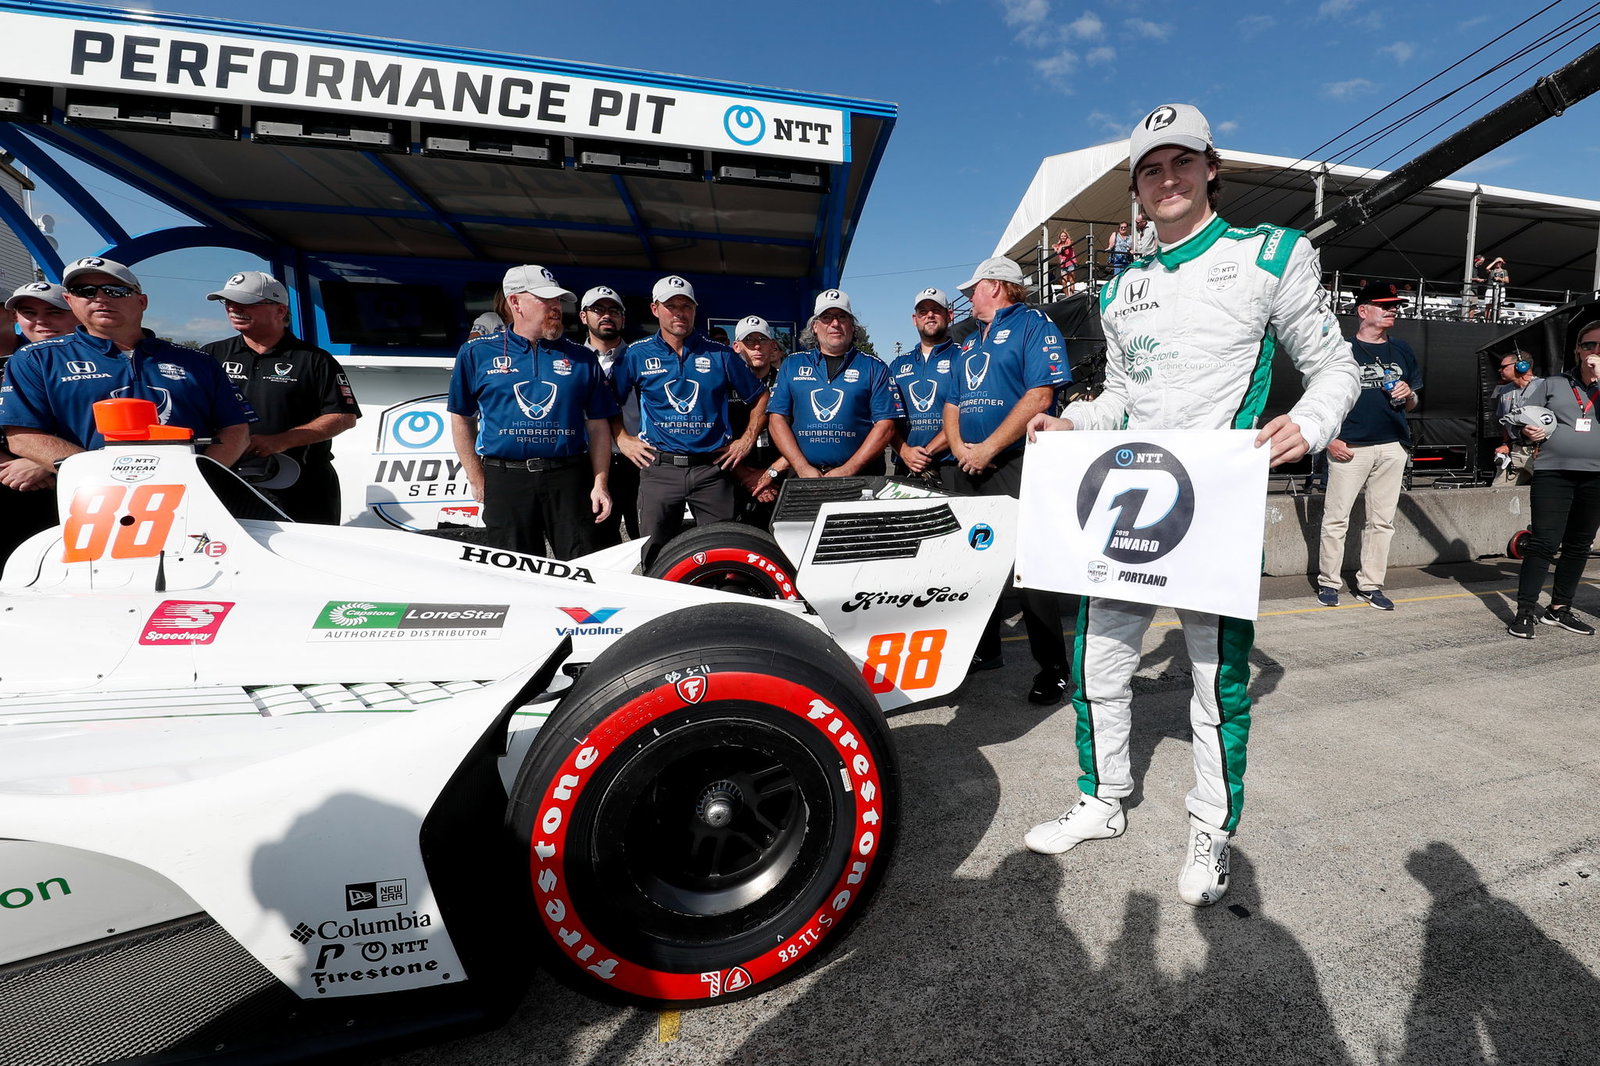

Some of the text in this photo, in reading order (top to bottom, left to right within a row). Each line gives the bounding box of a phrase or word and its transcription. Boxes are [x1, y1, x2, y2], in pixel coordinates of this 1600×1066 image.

[70, 29, 676, 135] PERFORMANCE PIT
[773, 117, 832, 146] NTT
[1221, 265, 1236, 274] NTT
[1206, 273, 1238, 284] INDYCAR
[1113, 301, 1160, 319] HONDA
[61, 372, 113, 382] HONDA
[641, 368, 668, 376] HONDA
[512, 420, 560, 428] HARDING
[498, 428, 576, 436] STEINBRENNER
[798, 430, 857, 438] STEINBRENNER
[516, 436, 557, 444] RACING
[1136, 452, 1163, 463] NTT
[408, 483, 468, 497] SERI
[62, 484, 186, 563] 88
[1109, 536, 1160, 553] AWARD
[459, 545, 596, 584] HONDA
[1117, 570, 1168, 588] PORTLAND
[842, 586, 969, 612] King Taco
[346, 609, 504, 621] Capstone LoneStar
[145, 630, 213, 642] Speedway
[324, 629, 487, 640] AUTHORIZED DISTRIBUTOR
[556, 626, 623, 636] Valvoline
[861, 629, 947, 695] 88
[806, 699, 880, 912] Firestone
[534, 746, 620, 979] Firestone
[380, 885, 402, 895] NEW
[381, 893, 403, 902] ERA
[317, 910, 432, 940] Columbia
[391, 939, 429, 955] NTT
[311, 959, 438, 988] Firestone
